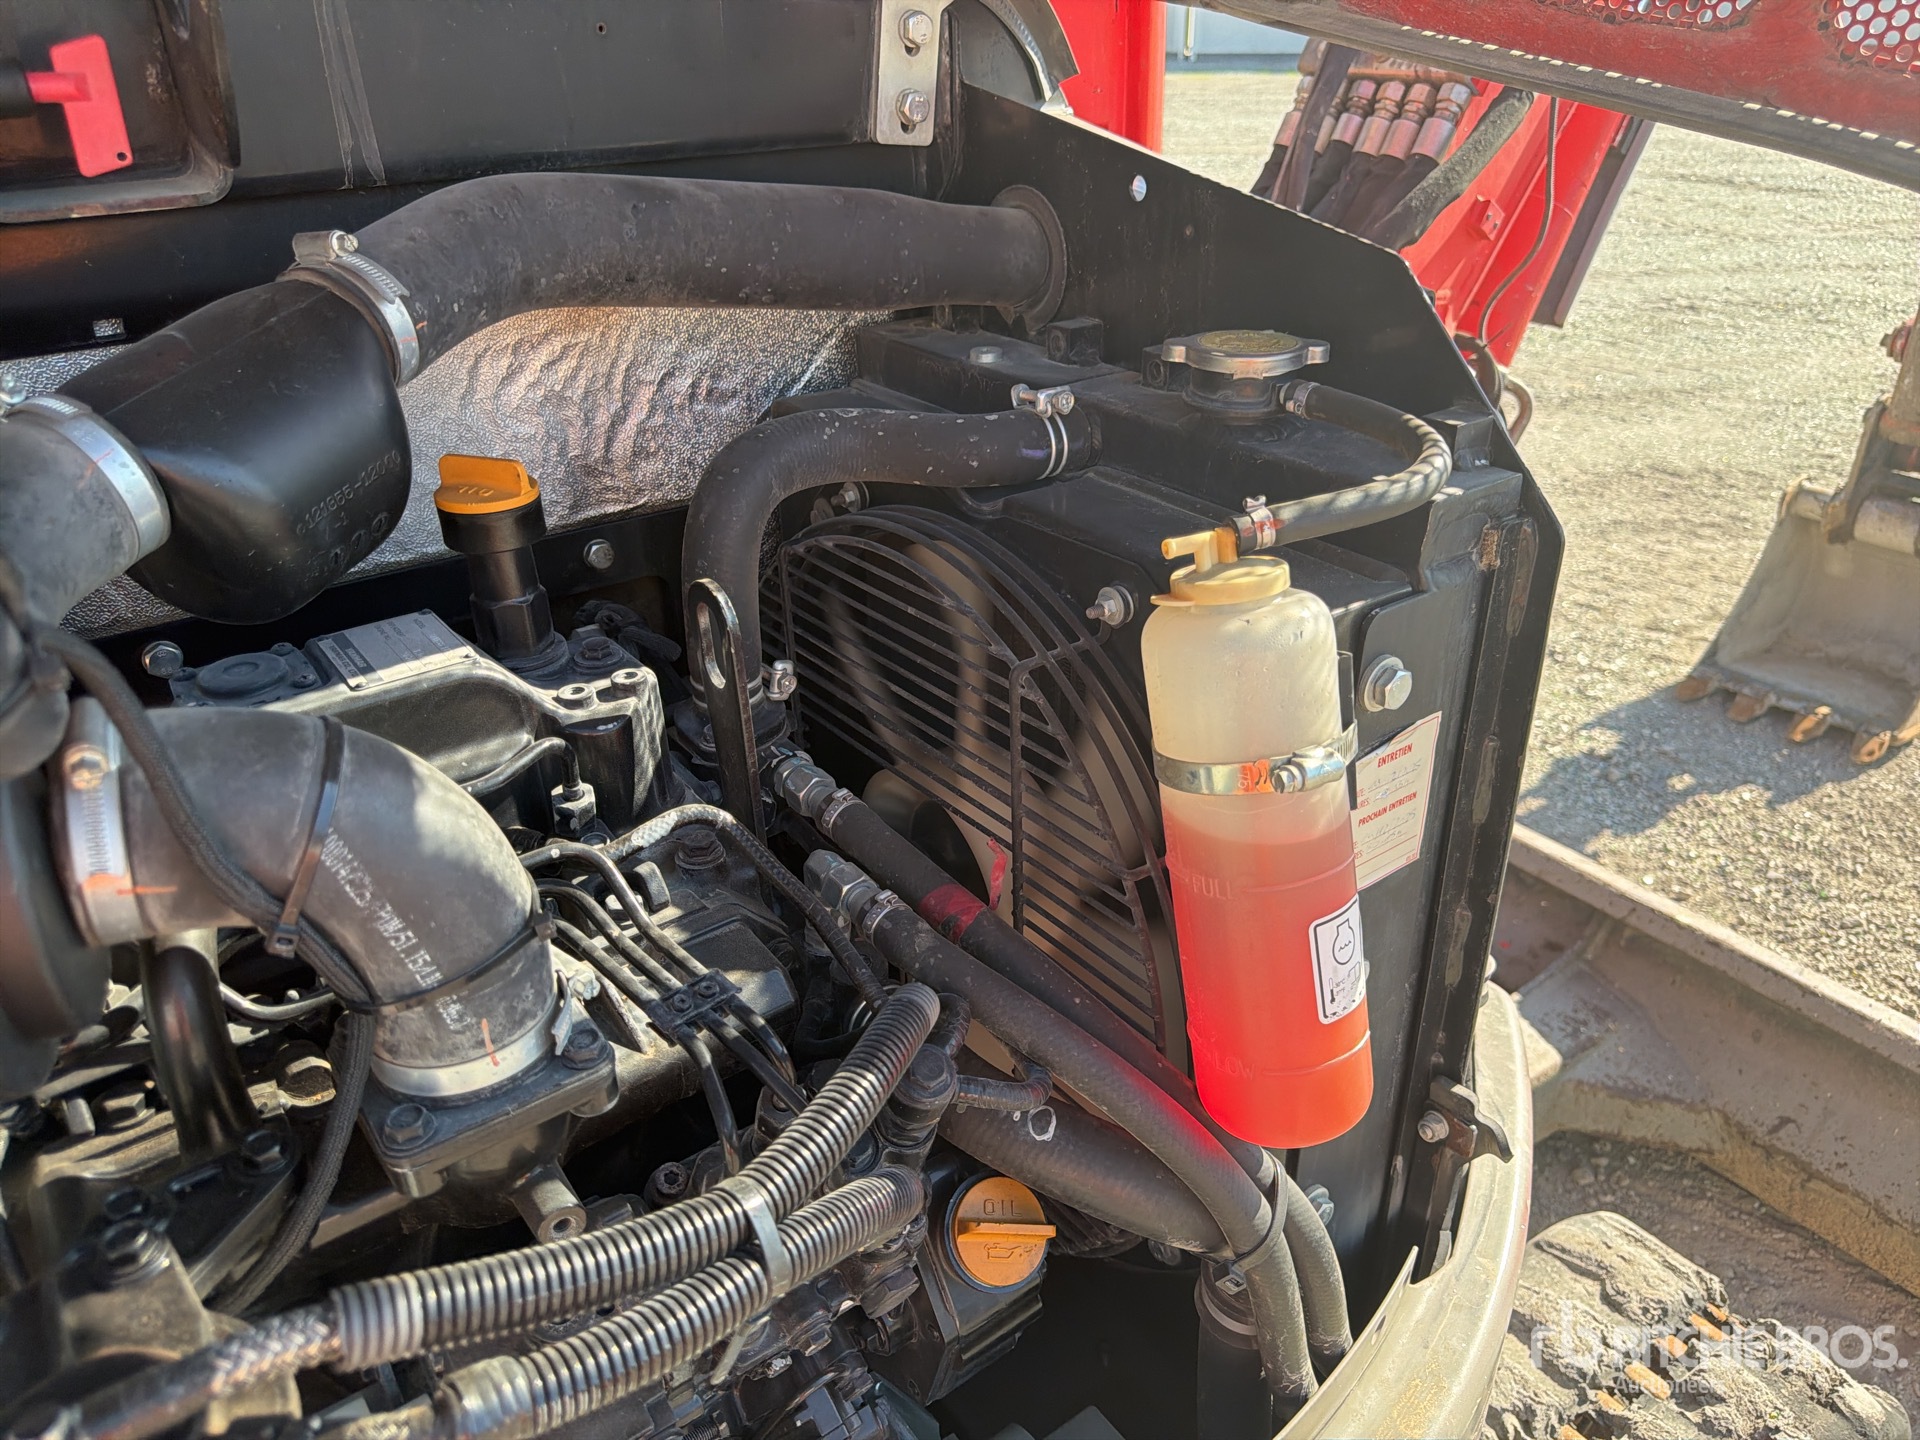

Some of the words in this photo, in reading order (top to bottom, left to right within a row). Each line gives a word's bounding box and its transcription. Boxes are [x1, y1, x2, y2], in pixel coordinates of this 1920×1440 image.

[1377, 743, 1413, 768] ENTRETIEN
[1358, 806, 1388, 828] PROCHAIN
[1388, 791, 1417, 812] ENTRETIEN
[1191, 873, 1238, 901] FULL
[1212, 1050, 1256, 1080] LOW
[983, 1198, 1023, 1218] OIL
